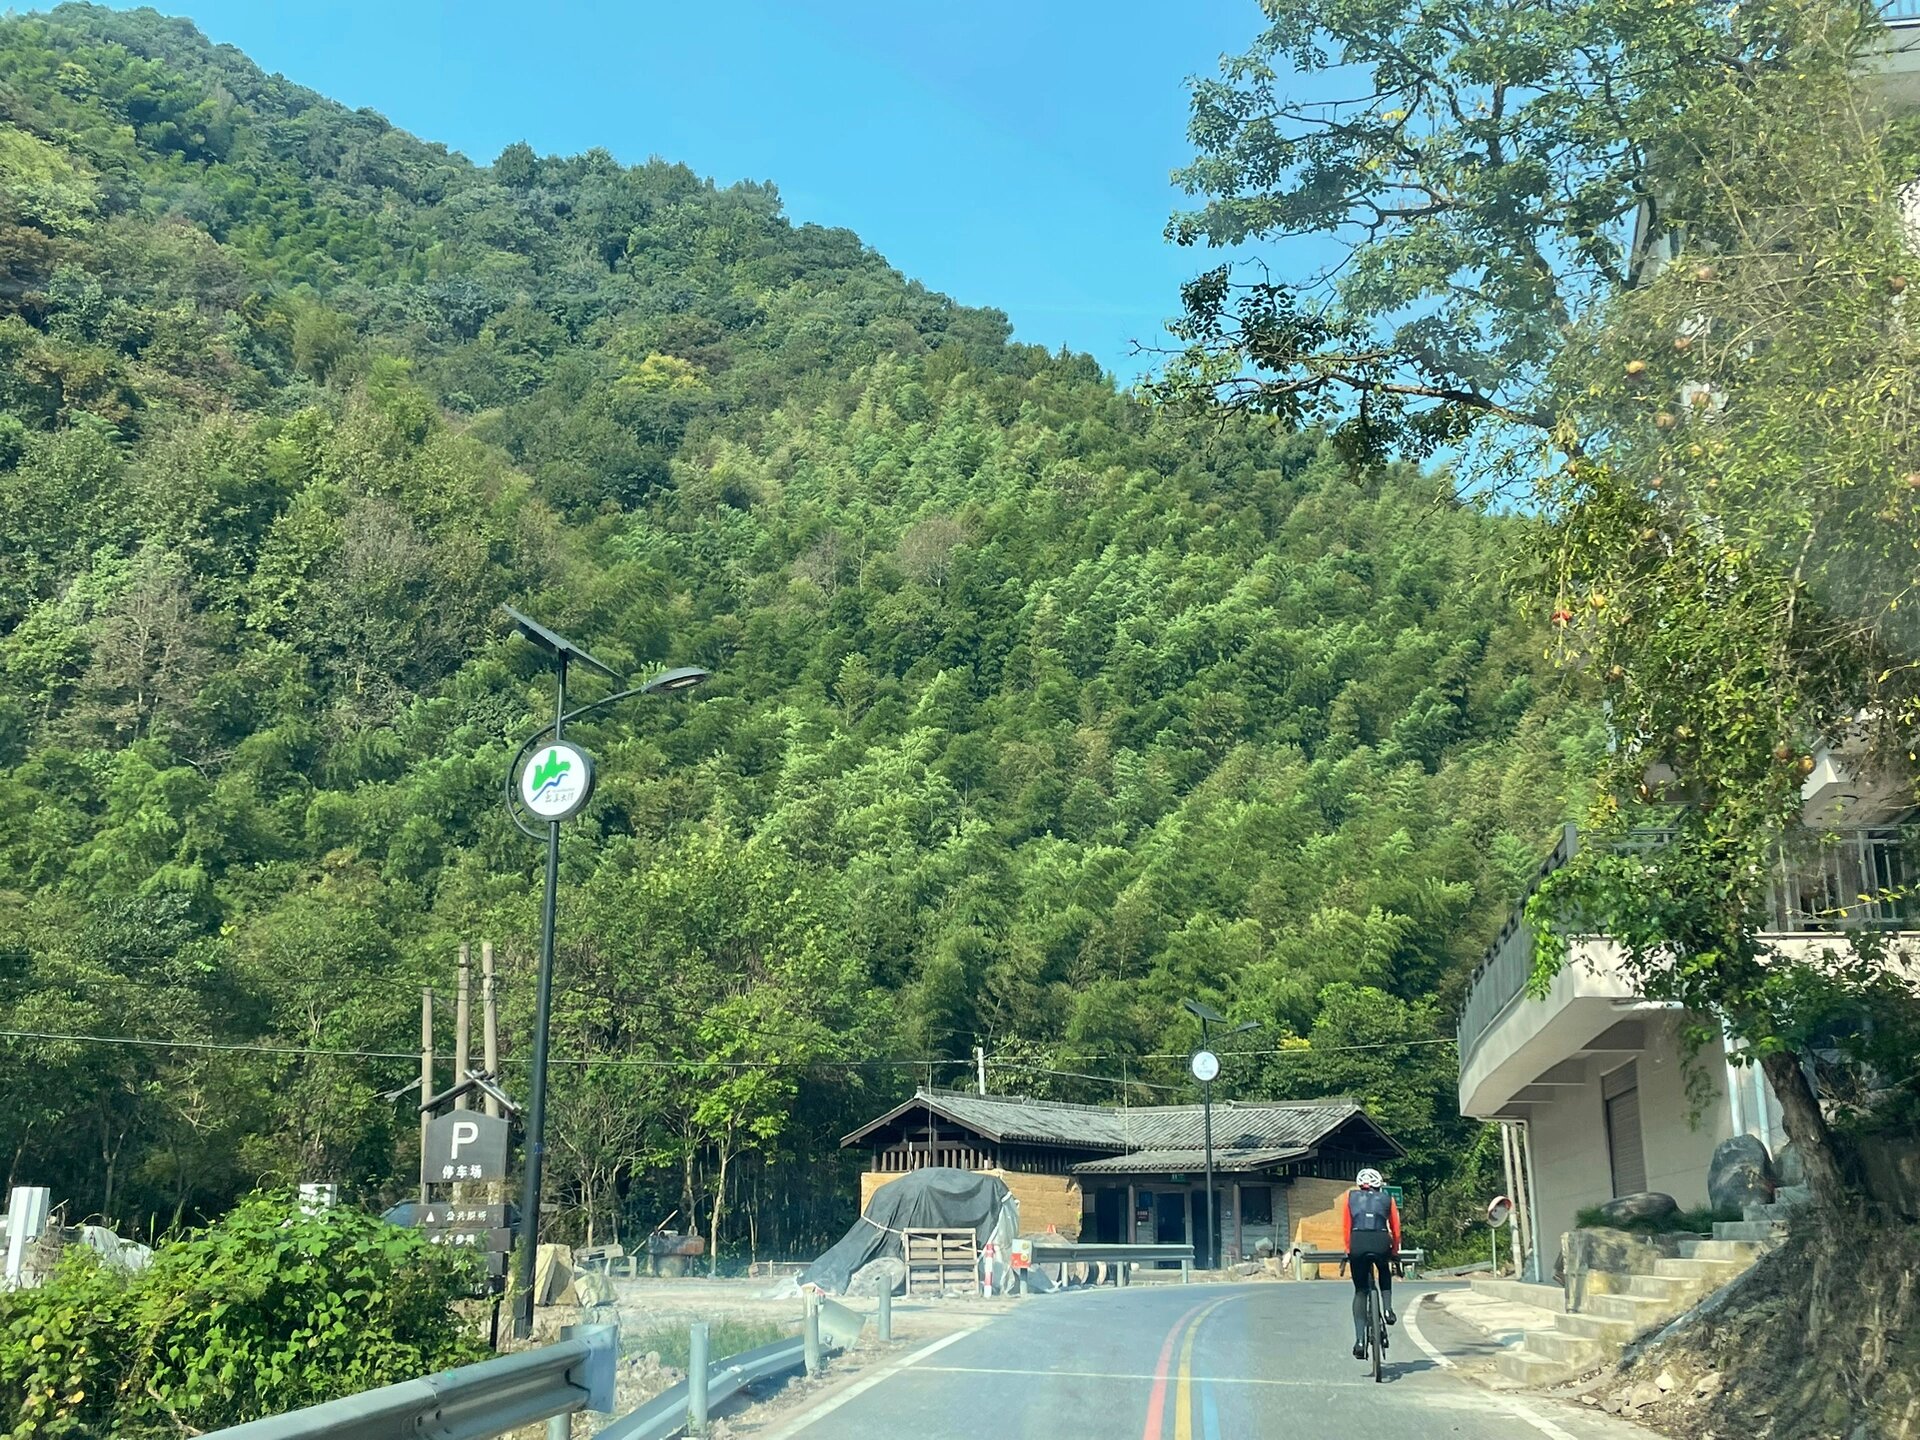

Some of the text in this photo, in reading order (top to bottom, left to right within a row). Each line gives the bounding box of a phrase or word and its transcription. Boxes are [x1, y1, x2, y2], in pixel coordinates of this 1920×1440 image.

[451, 1122, 478, 1160] P
[442, 1164, 482, 1179] 停车场
